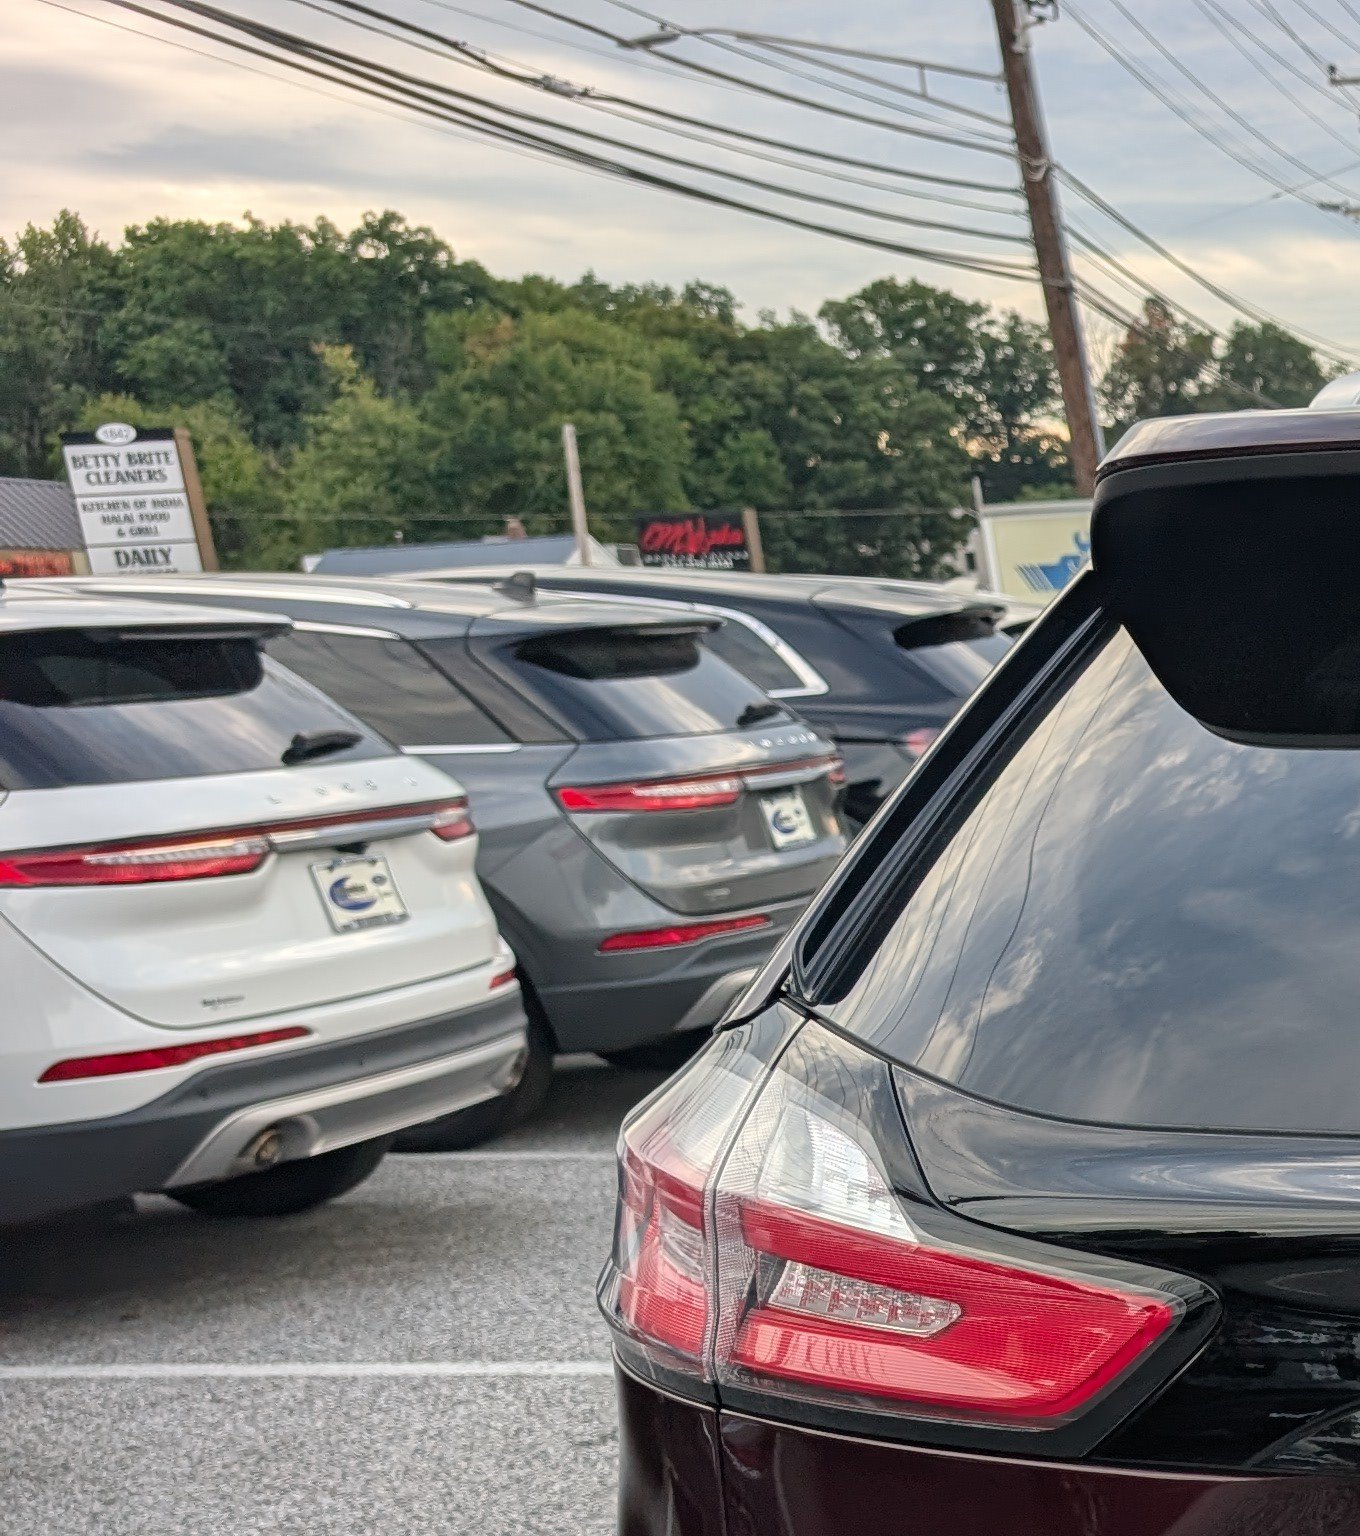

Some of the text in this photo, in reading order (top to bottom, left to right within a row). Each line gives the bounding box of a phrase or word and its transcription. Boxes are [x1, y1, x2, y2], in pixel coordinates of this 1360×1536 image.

[70, 450, 174, 470] BETTY BRITE
[85, 469, 168, 486] CLEANERS
[113, 548, 173, 568] DAILY
